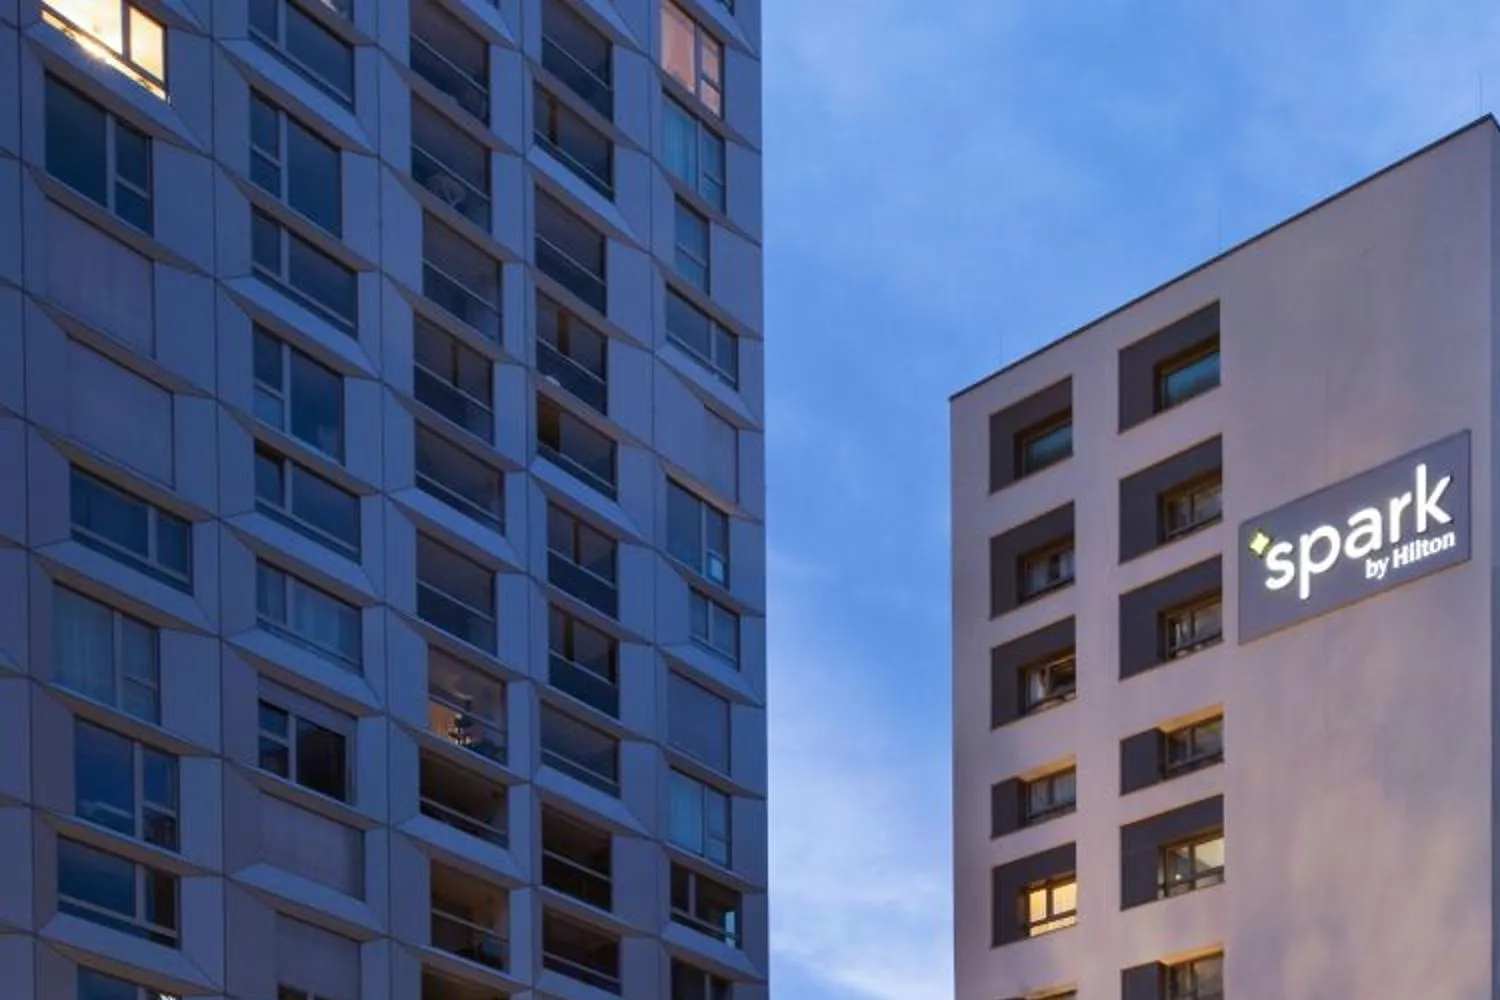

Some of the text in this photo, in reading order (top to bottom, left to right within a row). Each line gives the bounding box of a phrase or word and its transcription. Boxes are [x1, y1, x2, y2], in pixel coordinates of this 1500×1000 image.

[1265, 463, 1453, 600] spark
[1365, 531, 1456, 580] by Hilton
